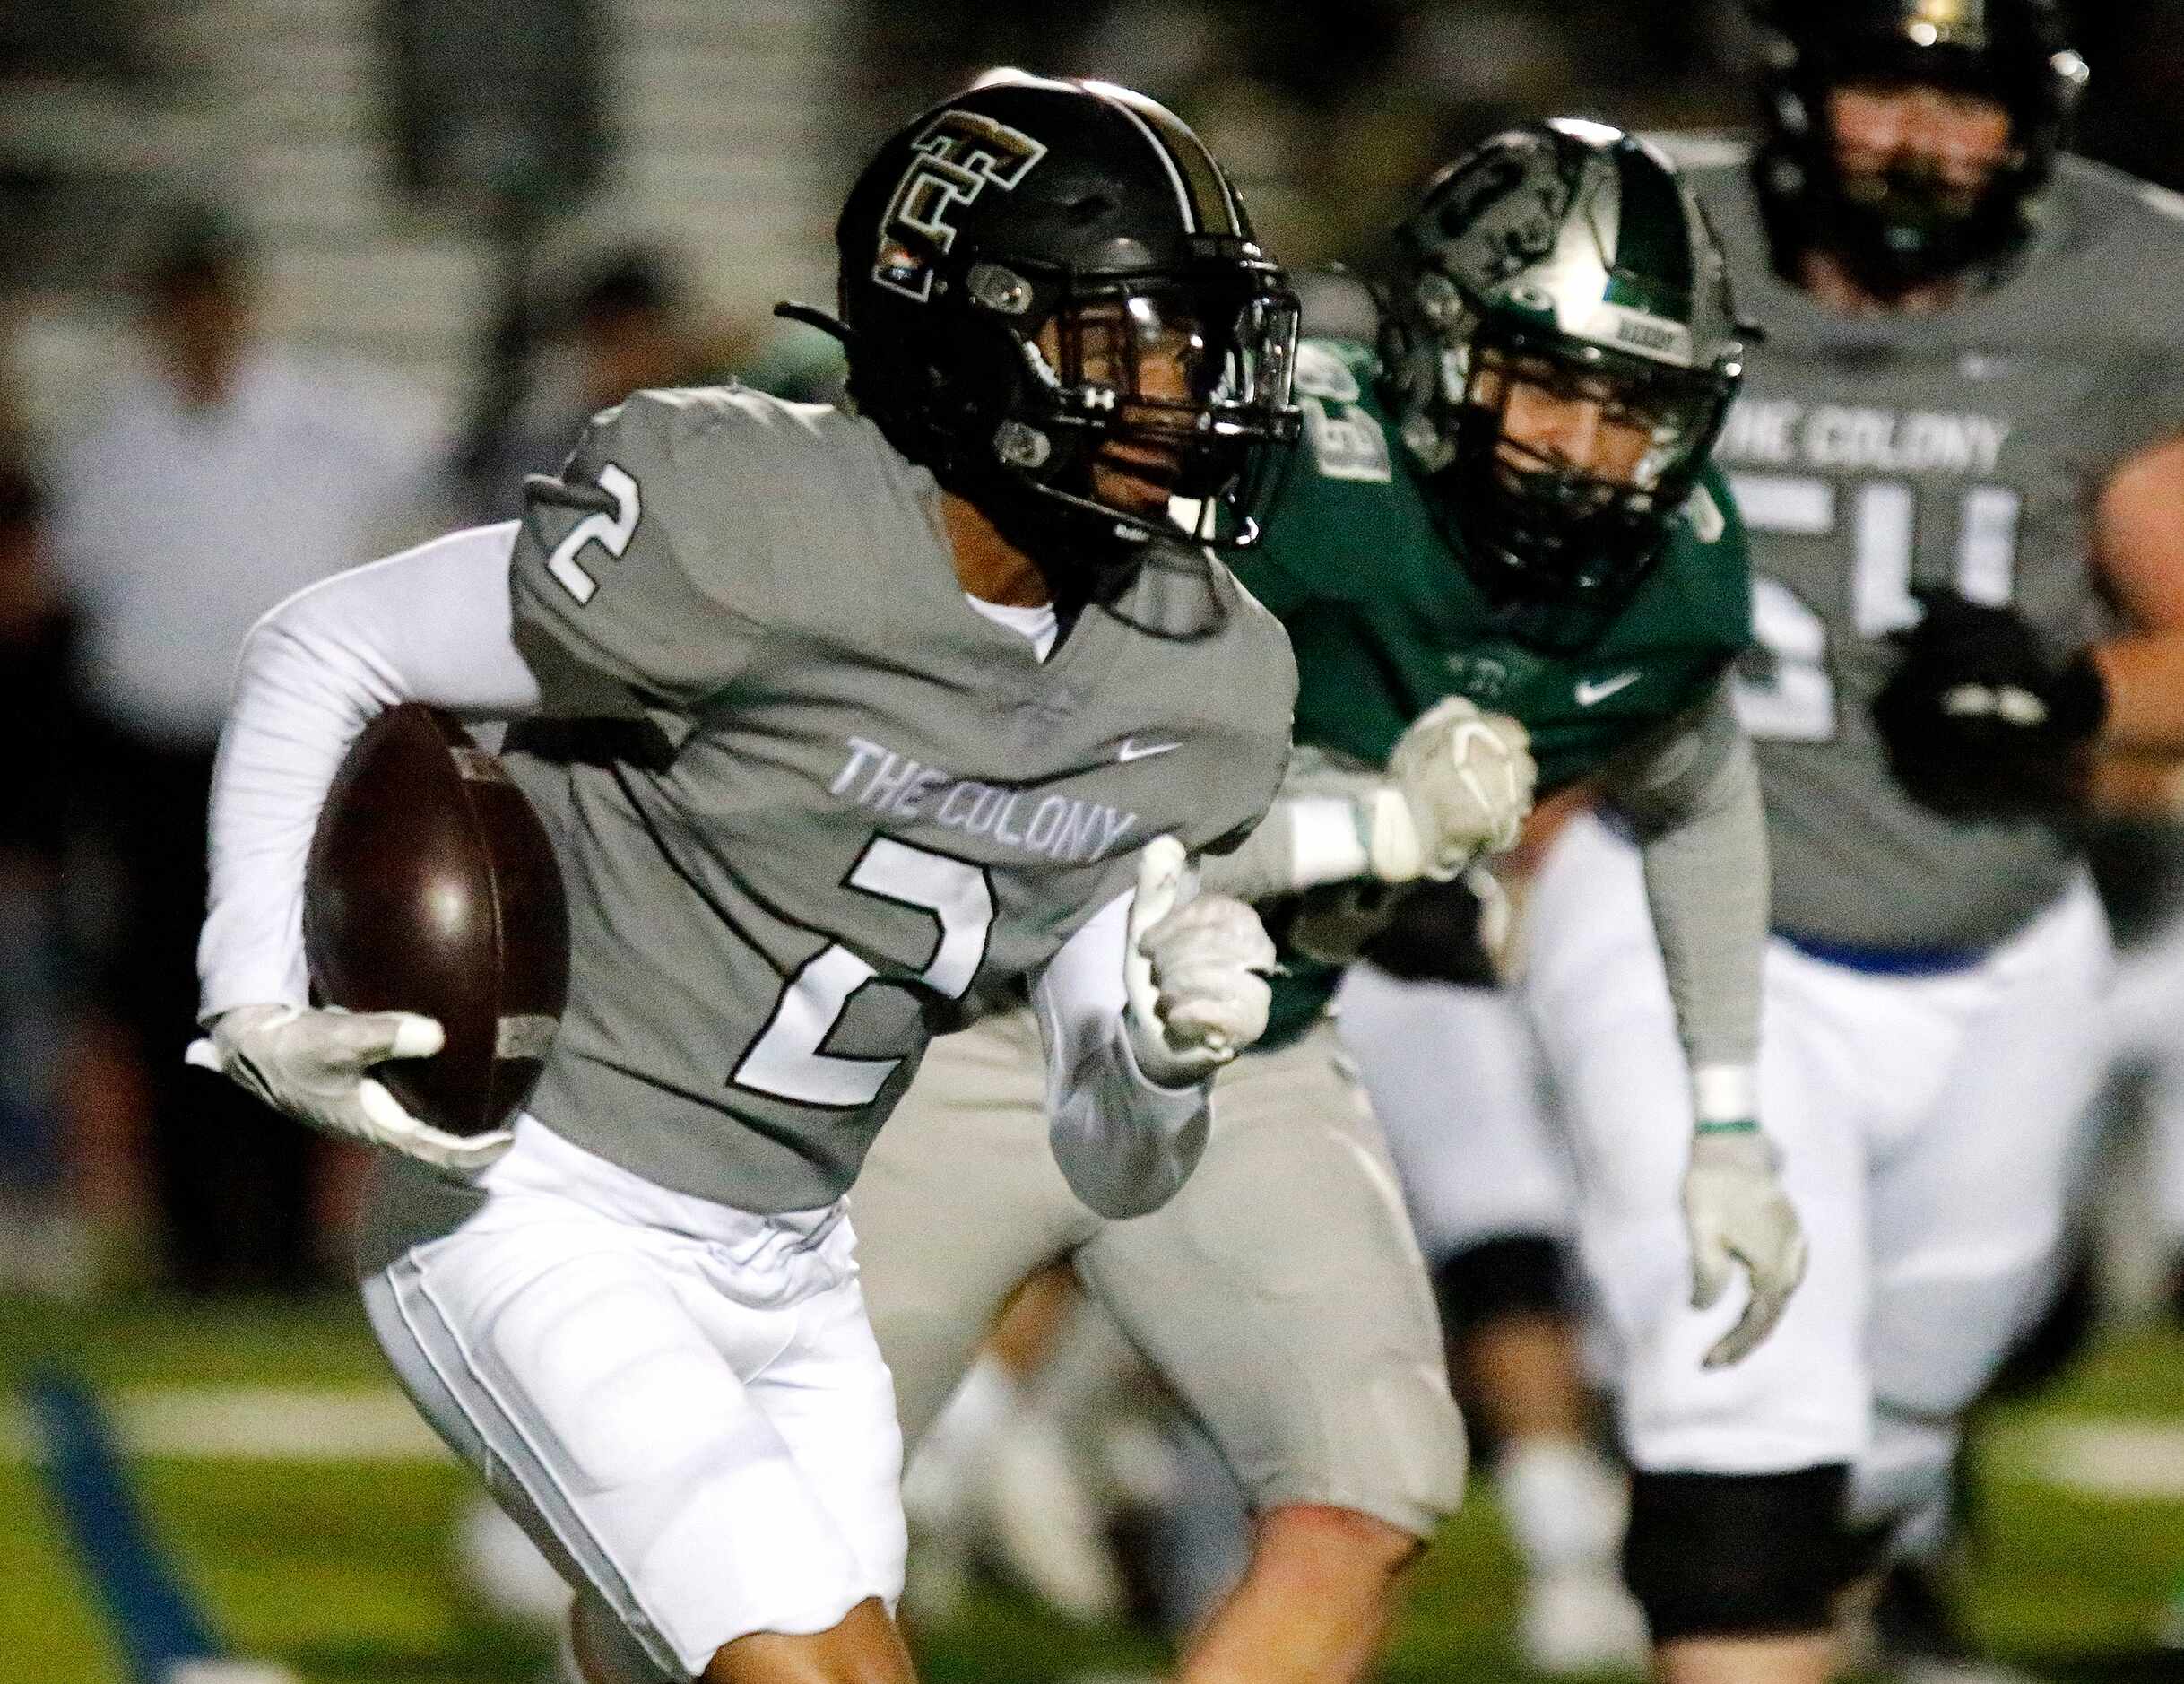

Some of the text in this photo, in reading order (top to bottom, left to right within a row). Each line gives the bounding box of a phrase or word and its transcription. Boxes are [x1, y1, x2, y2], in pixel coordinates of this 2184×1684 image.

[1803, 405, 2010, 472] COLONY
[546, 460, 642, 608] 2
[1726, 472, 2019, 742] 54
[829, 733, 1137, 863] THE COLONY
[728, 830, 998, 1110] 2
